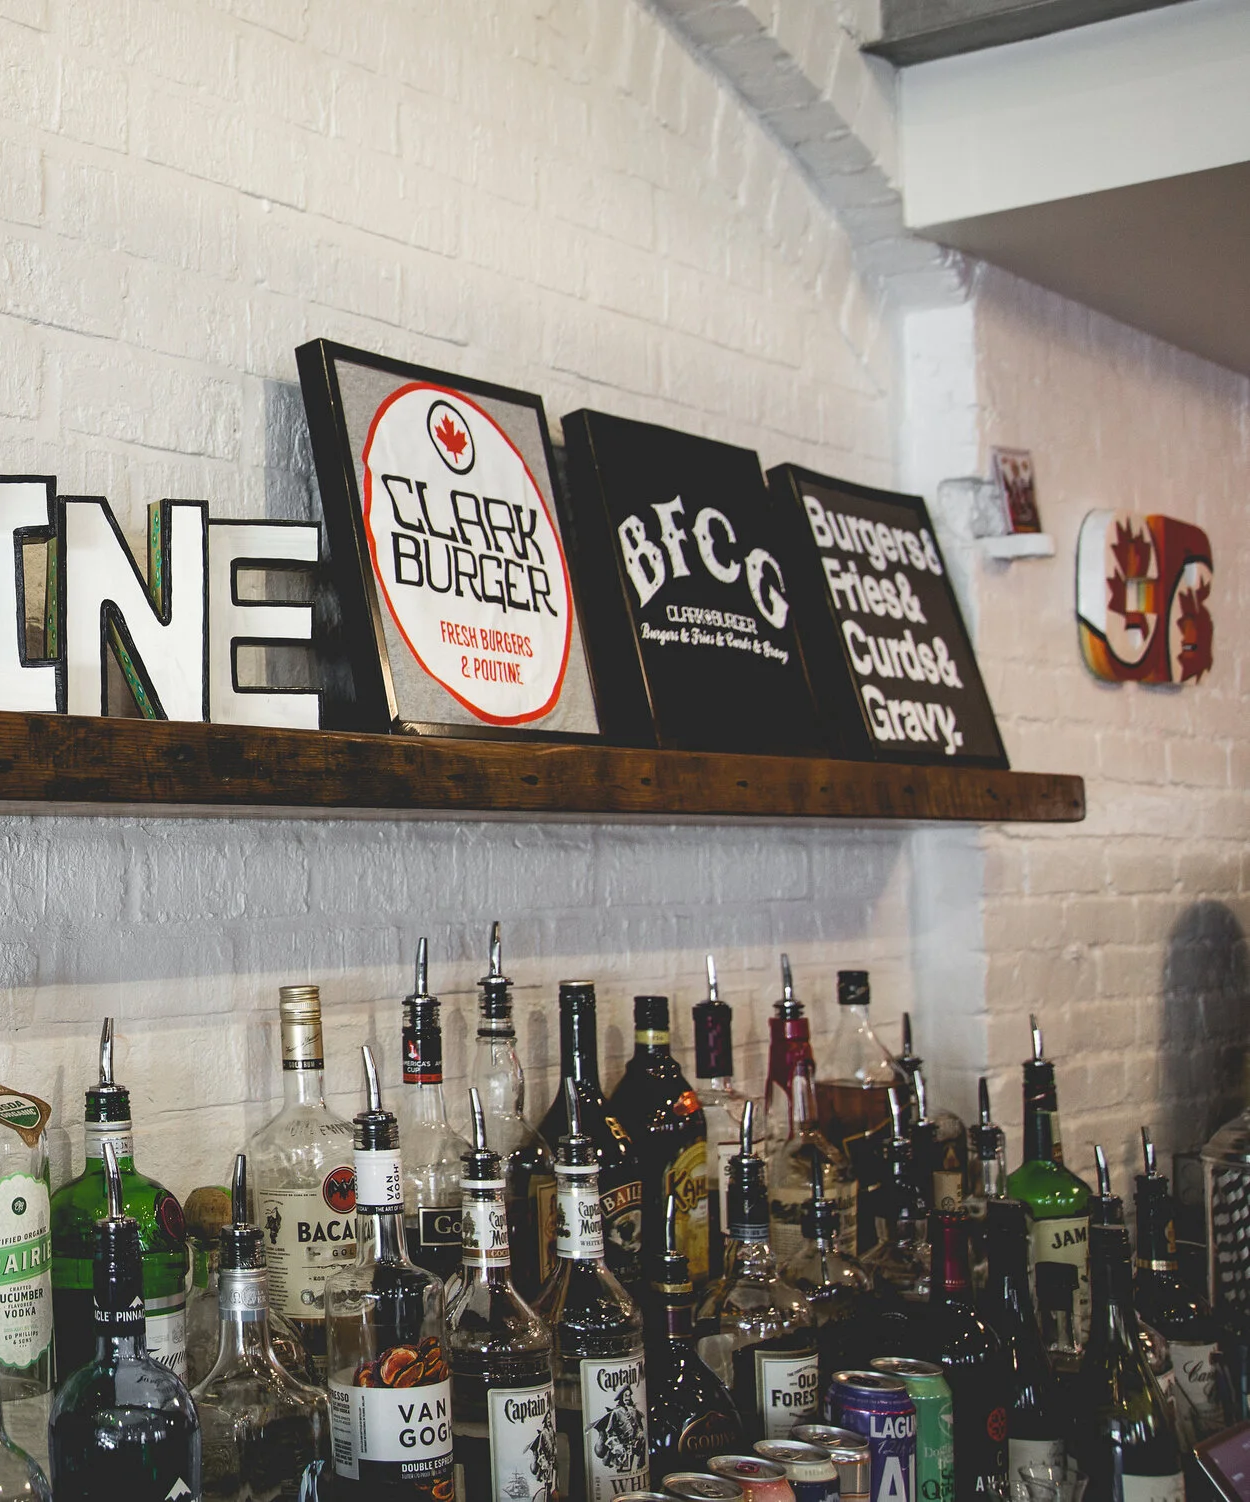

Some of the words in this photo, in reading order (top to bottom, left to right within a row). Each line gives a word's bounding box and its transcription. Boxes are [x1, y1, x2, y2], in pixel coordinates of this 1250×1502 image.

[381, 474, 545, 565] CLARK
[391, 531, 558, 617] BURGER
[666, 605, 702, 624] CLARK
[711, 610, 758, 634] BURGER
[440, 620, 479, 650] FRESH
[479, 628, 534, 658] BURGERS
[640, 622, 679, 646] Burgers
[691, 628, 715, 645] Fries
[725, 632, 752, 650] Curds
[762, 640, 789, 665] Gravy
[461, 655, 470, 679] &
[473, 658, 524, 685] POUTINE
[861, 684, 963, 755] Gravy.
[0, 1108, 37, 1118] ORGANIC
[386, 1175, 394, 1200] VAN
[24, 1226, 47, 1240] ORGANIC
[434, 1215, 462, 1234] Go
[1051, 1226, 1087, 1249] JAM
[4, 1306, 36, 1319] VODKA
[14, 1331, 38, 1339] PHILLIPS
[597, 1364, 637, 1392] Captain
[798, 1373, 817, 1389] OLD
[504, 1394, 545, 1424] Captain
[772, 1389, 818, 1407] FORES
[398, 1398, 447, 1424] VAN
[401, 1461, 433, 1473] DOUBLE
